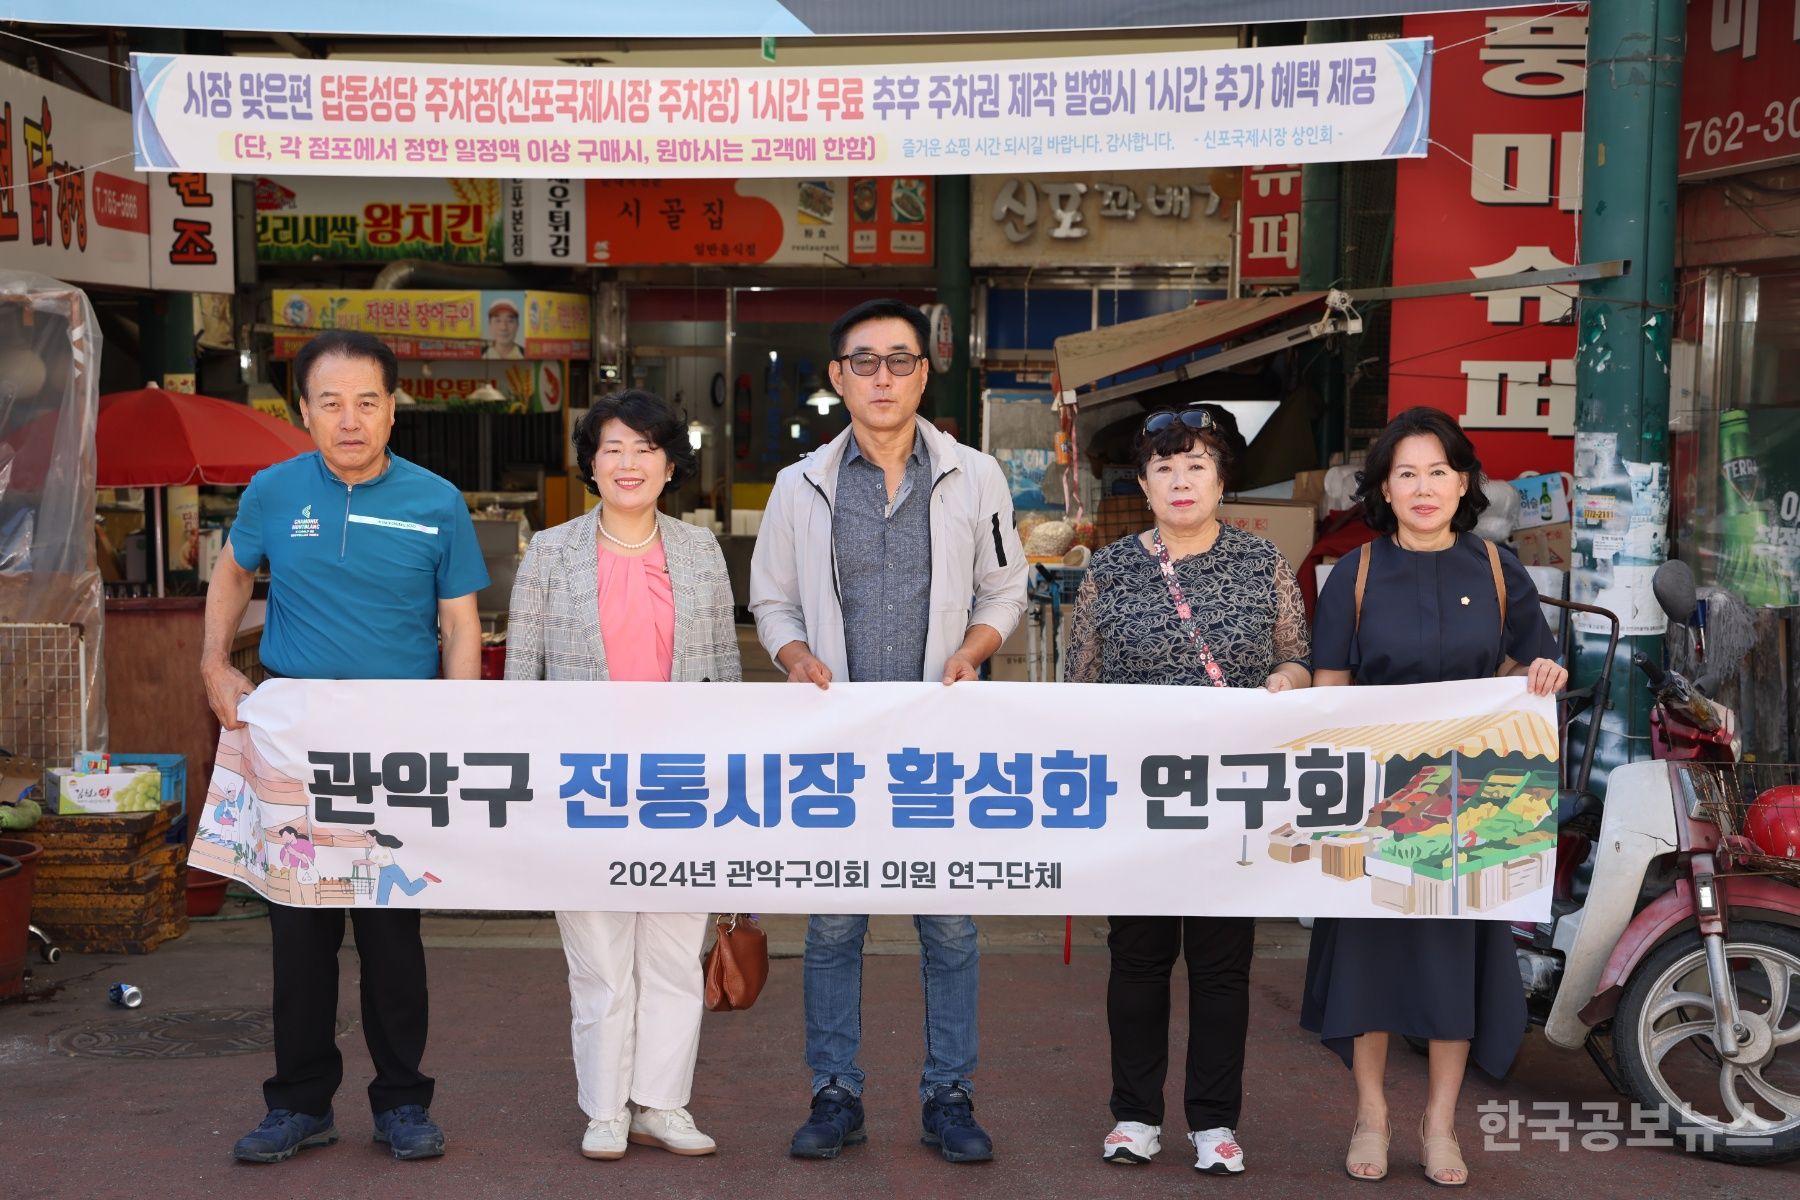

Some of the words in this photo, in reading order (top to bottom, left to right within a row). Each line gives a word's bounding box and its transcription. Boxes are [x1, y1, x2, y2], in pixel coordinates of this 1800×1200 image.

[183, 71, 232, 119] 시장
[240, 73, 313, 120] 맞은편
[320, 75, 418, 123] 답동성당
[425, 77, 652, 124] 주차장(신포국제시장
[658, 77, 740, 124] 주차장)
[748, 78, 810, 122] 1시간
[817, 77, 864, 122] 무료
[872, 75, 920, 121] 추후
[928, 73, 1000, 120] 주차권
[1008, 71, 1057, 117] 제작
[1065, 67, 1136, 116] 발행시
[1145, 63, 1207, 113] 1시간
[1215, 62, 1264, 111] 추가
[1272, 59, 1320, 109] 혜택
[1326, 57, 1376, 107] 제공
[234, 133, 272, 161] (단,
[279, 135, 301, 160] 각
[308, 137, 397, 161] 점포에서
[404, 138, 448, 162] 정한
[455, 138, 520, 163] 일정액
[527, 138, 571, 163] 이상
[577, 138, 650, 165] 구매시,
[656, 138, 743, 162] 원하시는
[751, 137, 816, 161] 고객에
[823, 135, 876, 161] 한함)
[901, 137, 941, 158] 즐거운
[945, 137, 970, 156] 쇼핑
[975, 136, 1001, 156] 시간
[1004, 135, 1043, 155] 되시길
[1047, 133, 1102, 154] 바랍니다.
[1106, 131, 1175, 152] 감사합니다.
[1203, 128, 1287, 149] 신포국제시장
[1291, 125, 1333, 146] 상인회
[363, 203, 485, 246] 왕치킨
[511, 179, 524, 257] 포본점
[547, 179, 571, 257] 우튀김
[415, 299, 475, 330] 장어구이
[307, 751, 533, 828] 관악구
[559, 751, 865, 829] 전통시장
[887, 747, 1117, 830] 활성화
[1140, 748, 1365, 830] 연구회
[609, 860, 716, 888] 2024년
[726, 860, 869, 888] 관악구의회
[881, 861, 936, 889] 의원
[947, 861, 1062, 890] 연구단체
